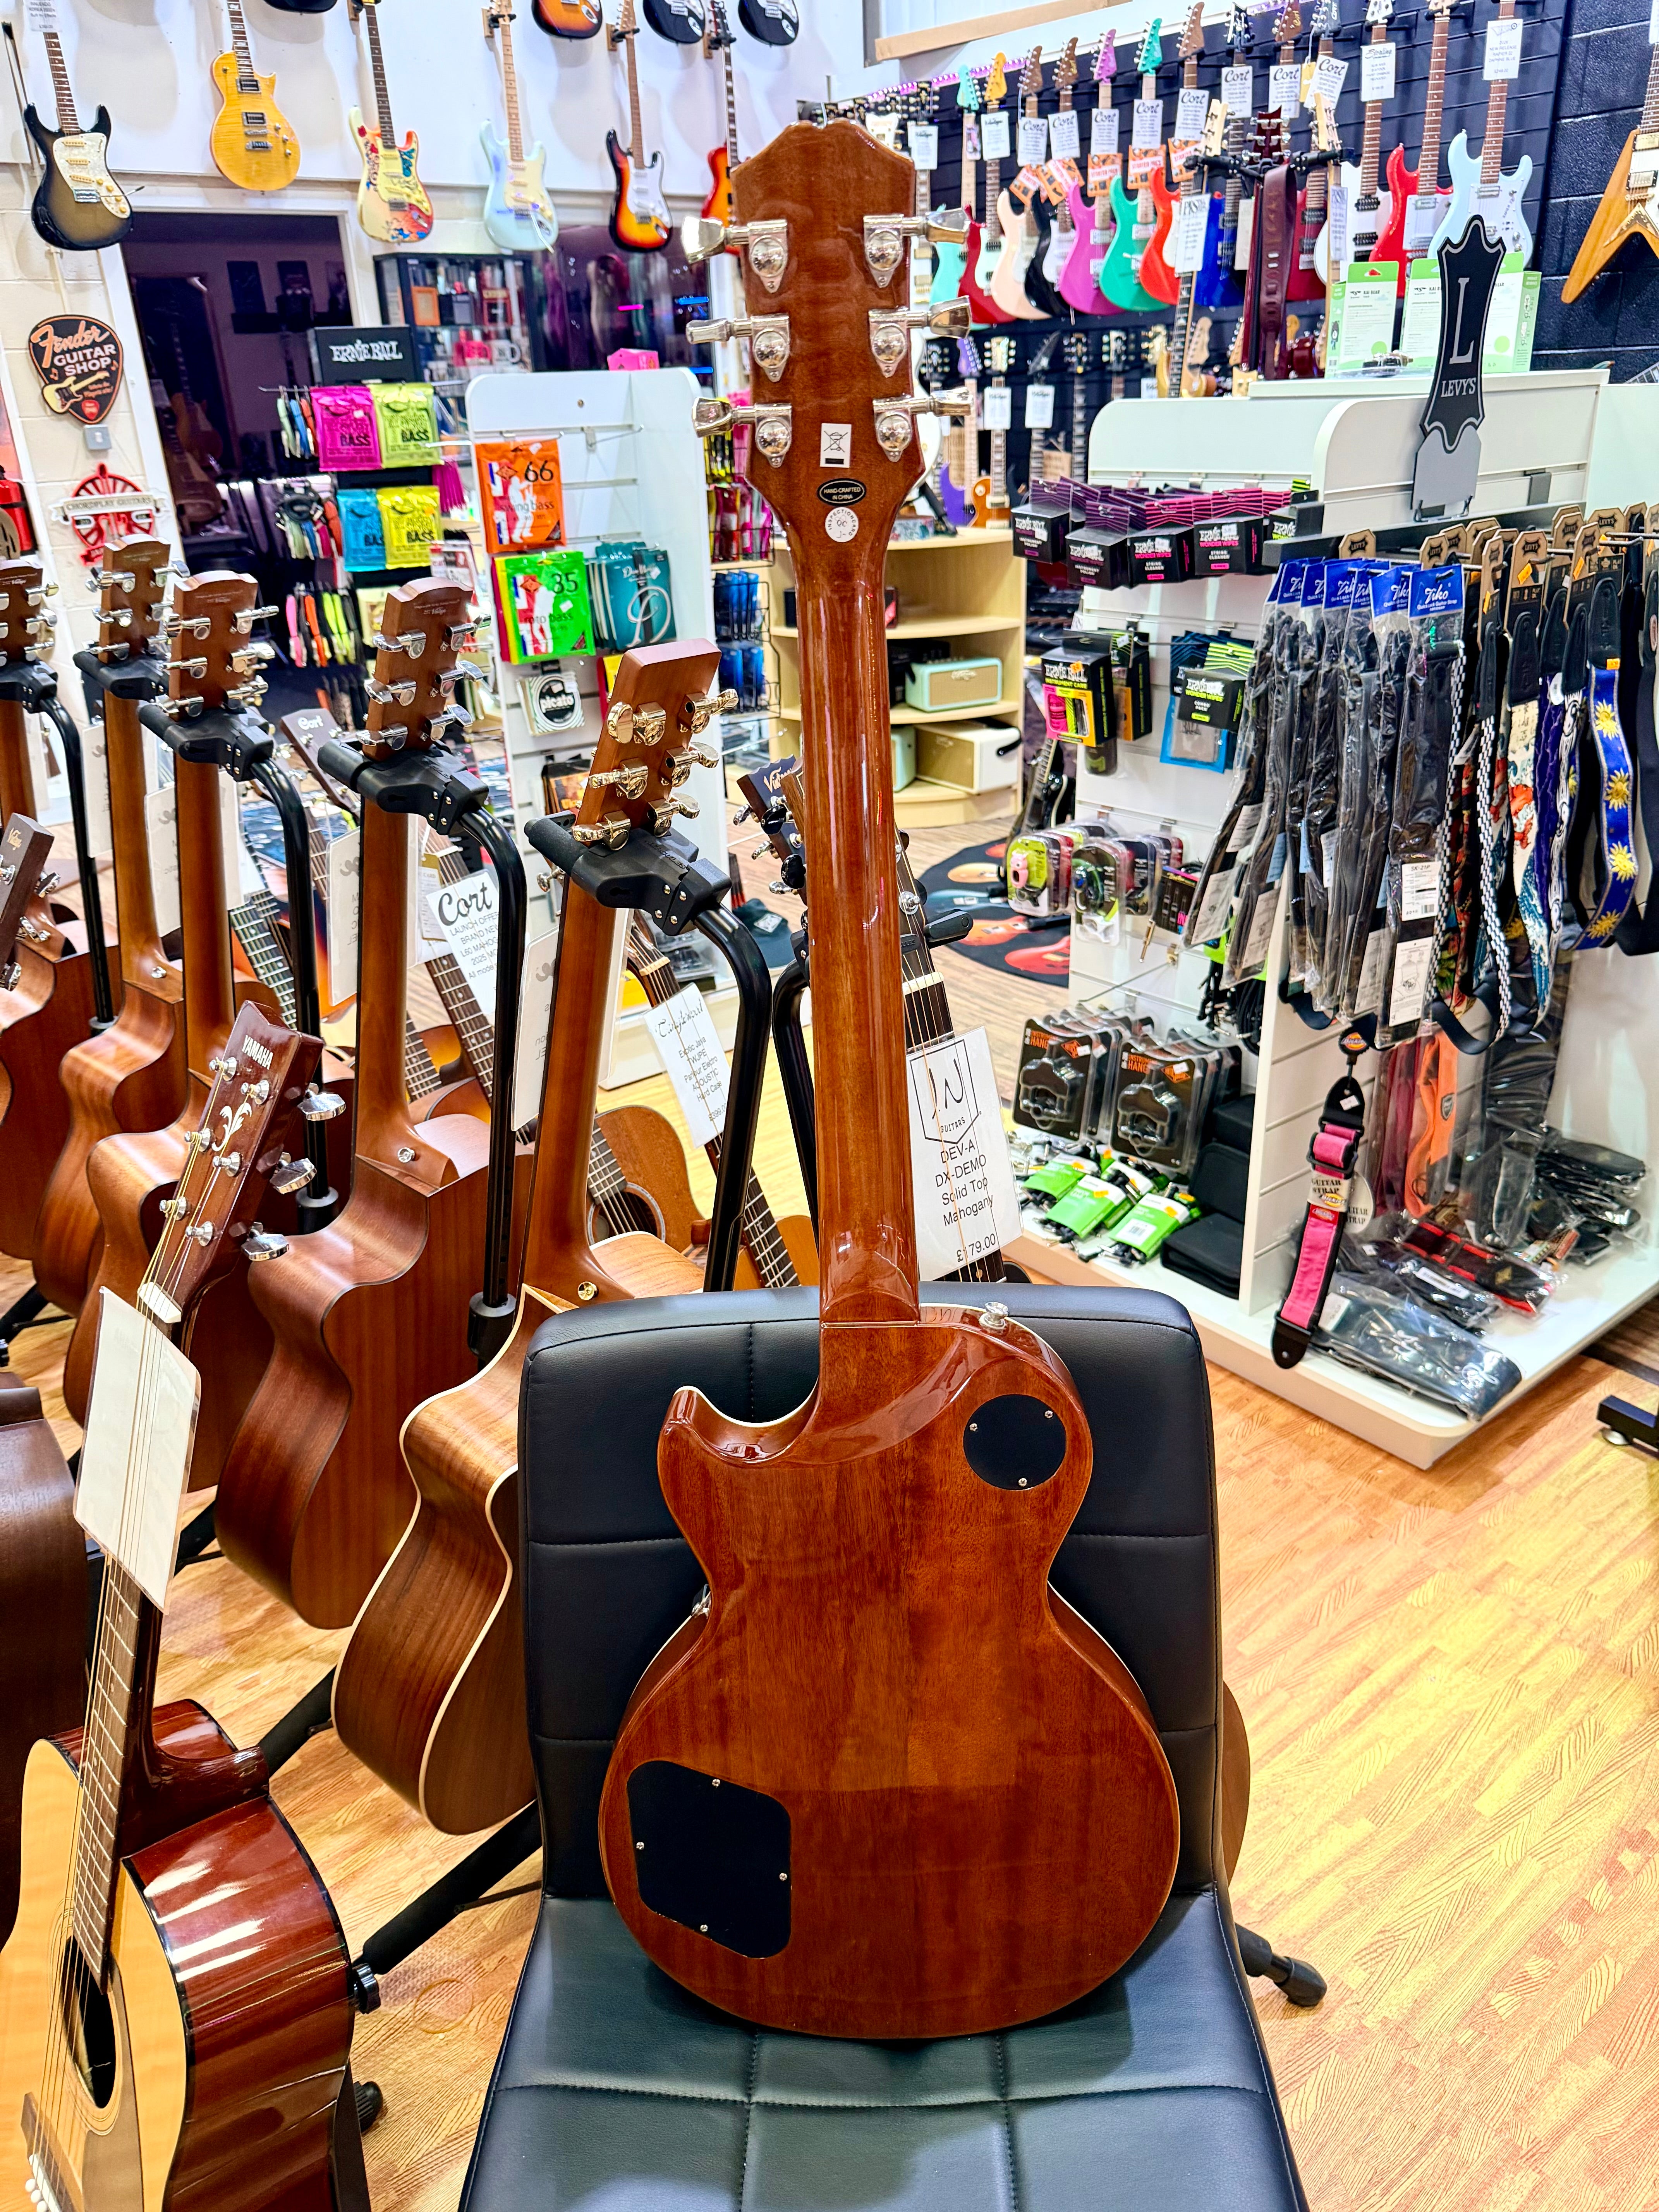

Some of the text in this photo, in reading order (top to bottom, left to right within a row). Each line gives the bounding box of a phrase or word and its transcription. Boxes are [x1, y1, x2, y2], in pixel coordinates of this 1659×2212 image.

[1273, 68, 1299, 81] Cort
[1319, 59, 1345, 76] Cort
[1224, 70, 1250, 82] Cort
[1181, 90, 1206, 104] Cort
[1137, 102, 1159, 114] Cort
[1449, 277, 1474, 364] L
[31, 320, 110, 368] Fender
[329, 339, 403, 362] ERNIE BALL
[53, 344, 116, 366] GUITAR
[64, 357, 111, 376] SHOP
[1441, 378, 1476, 398] LEVY'S
[340, 434, 371, 446] BASS
[402, 429, 429, 442] BASS
[525, 460, 554, 482] 66
[531, 499, 554, 510] bass
[364, 534, 384, 546] BAS
[407, 531, 434, 543] BASS
[1199, 527, 1221, 541] ERNIE
[1044, 663, 1066, 679] ERNIE
[540, 694, 574, 713] picato
[298, 715, 324, 730] Cort
[438, 882, 492, 926] Cort
[450, 920, 477, 936] LAUNCH
[460, 931, 485, 945] BRAND
[460, 937, 498, 957] L60 MAHOG
[471, 953, 487, 965] 2025
[678, 1036, 706, 1058] Exotic Java
[1030, 1038, 1049, 1049] HANG
[242, 1035, 273, 1070] YAMAHA
[687, 1048, 708, 1064] TWJPE
[702, 1056, 718, 1070] Electro
[1128, 1060, 1149, 1074] HANG
[692, 1068, 720, 1092] ACOUSTIC
[697, 1080, 722, 1102] Hard Case
[940, 1117, 965, 1133] GUITARS
[941, 1139, 975, 1164] DEV-A
[935, 1154, 986, 1188] DX-DEMO
[1312, 1178, 1341, 1186] GUITAR
[1312, 1186, 1340, 1194] STRAP
[942, 1176, 988, 1206] Solid Top
[943, 1194, 993, 1227] Mahogany
[957, 1233, 996, 1262] £179.00
